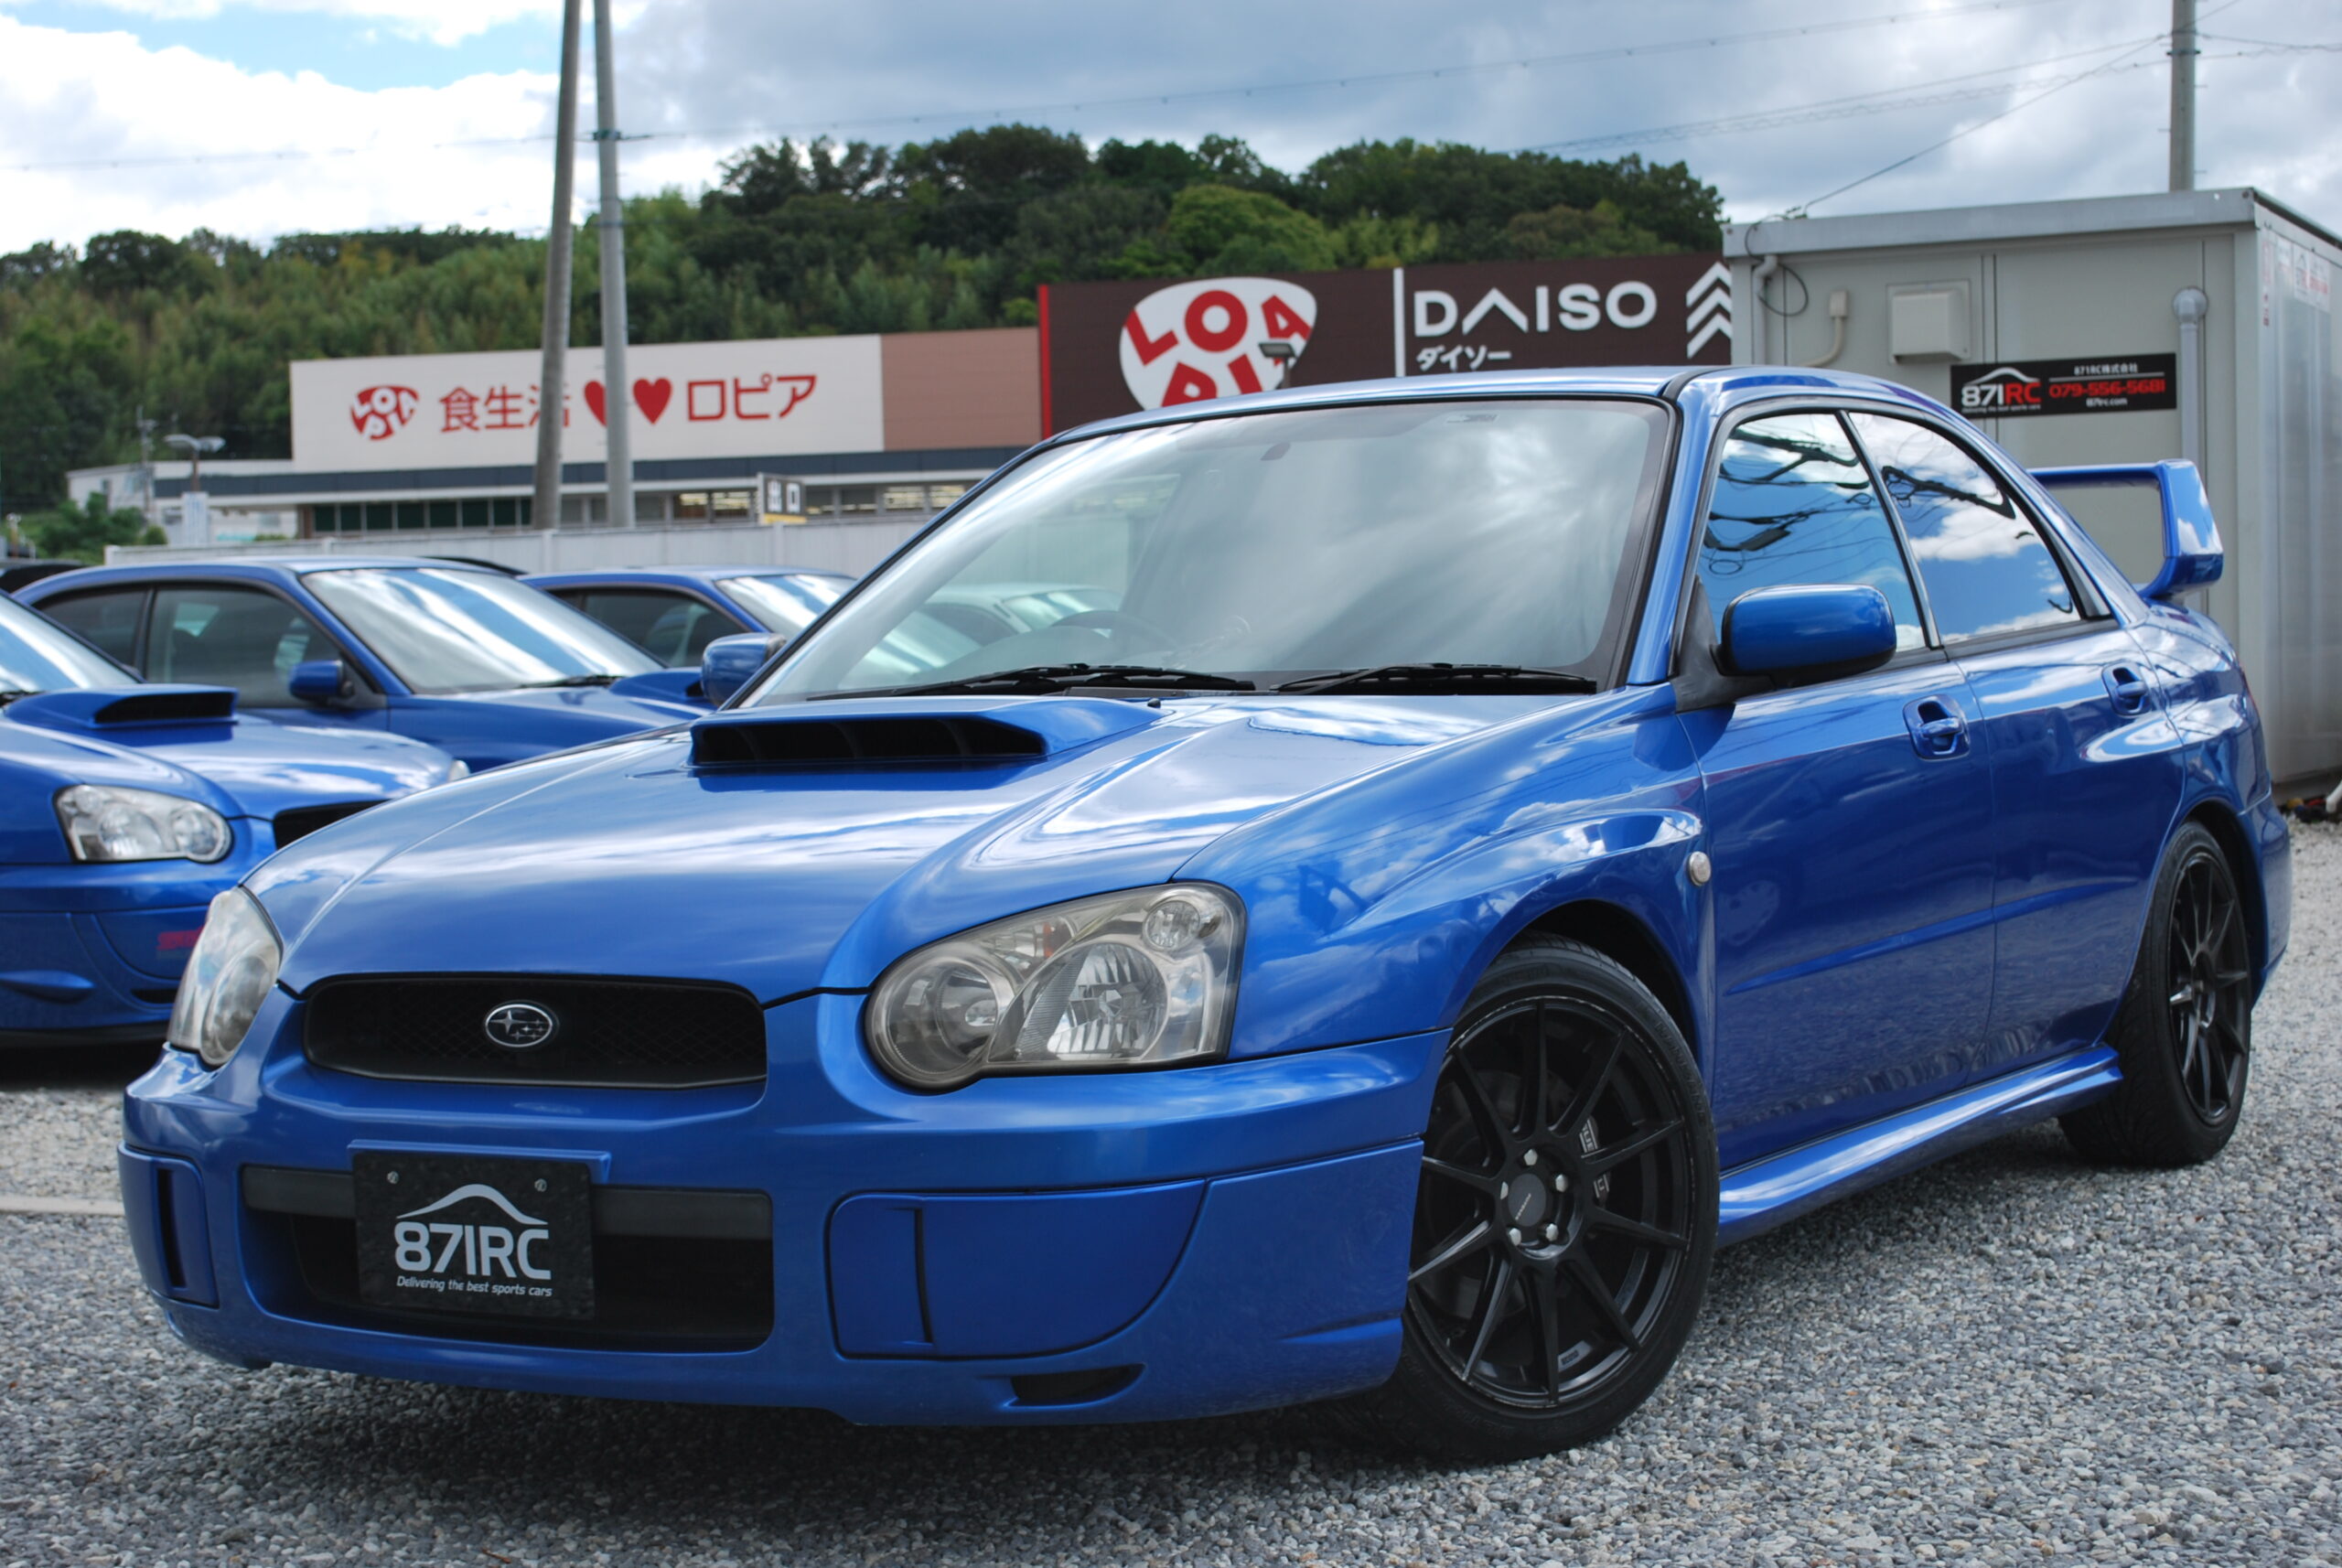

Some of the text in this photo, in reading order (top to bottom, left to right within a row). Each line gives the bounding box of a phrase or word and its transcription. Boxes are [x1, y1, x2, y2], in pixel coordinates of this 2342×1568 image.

[1413, 281, 1658, 338] DAISO
[1416, 345, 1511, 371] ダイソー
[688, 373, 816, 422] ロピア
[2049, 379, 2165, 398] 079-556-5681
[396, 1275, 553, 1297] Delivering the best sports cars
